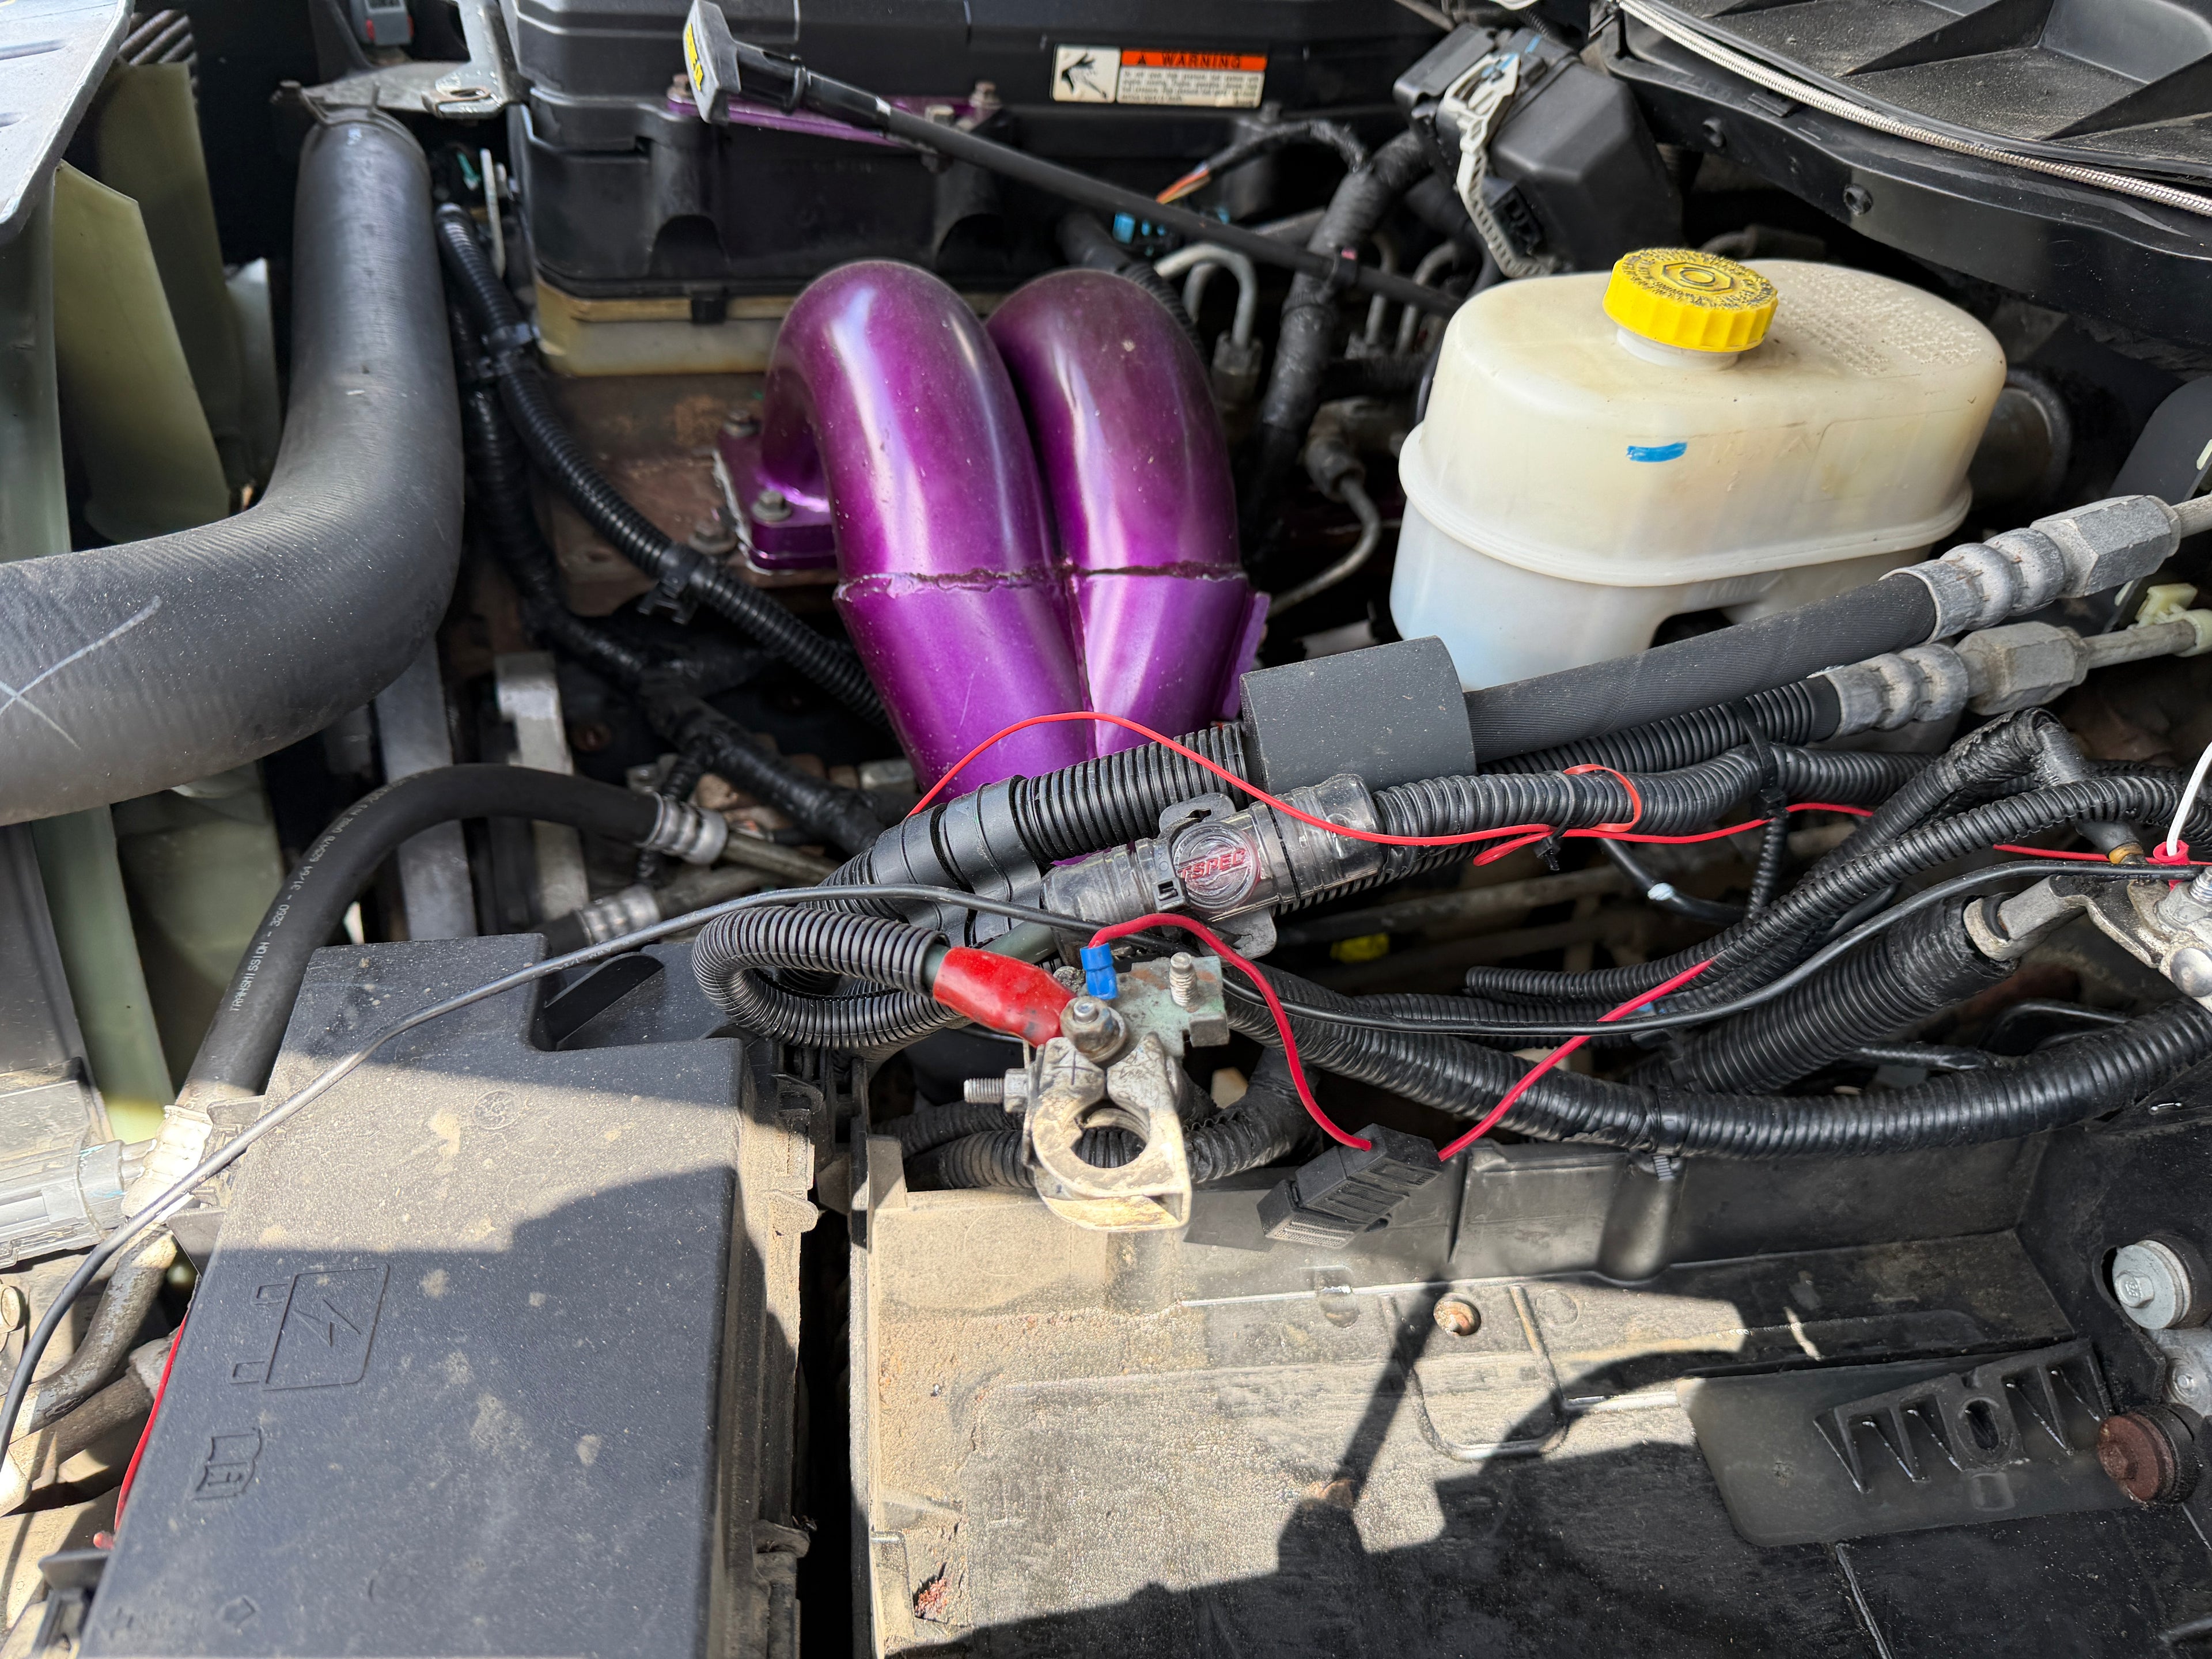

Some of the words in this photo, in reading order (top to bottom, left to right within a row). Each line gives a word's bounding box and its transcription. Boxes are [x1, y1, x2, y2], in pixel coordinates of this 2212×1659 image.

[1162, 52, 1240, 69] WARNING
[232, 941, 270, 1011] TRANSMISSION
[270, 904, 290, 927] 3260
[290, 866, 313, 891] 31/64
